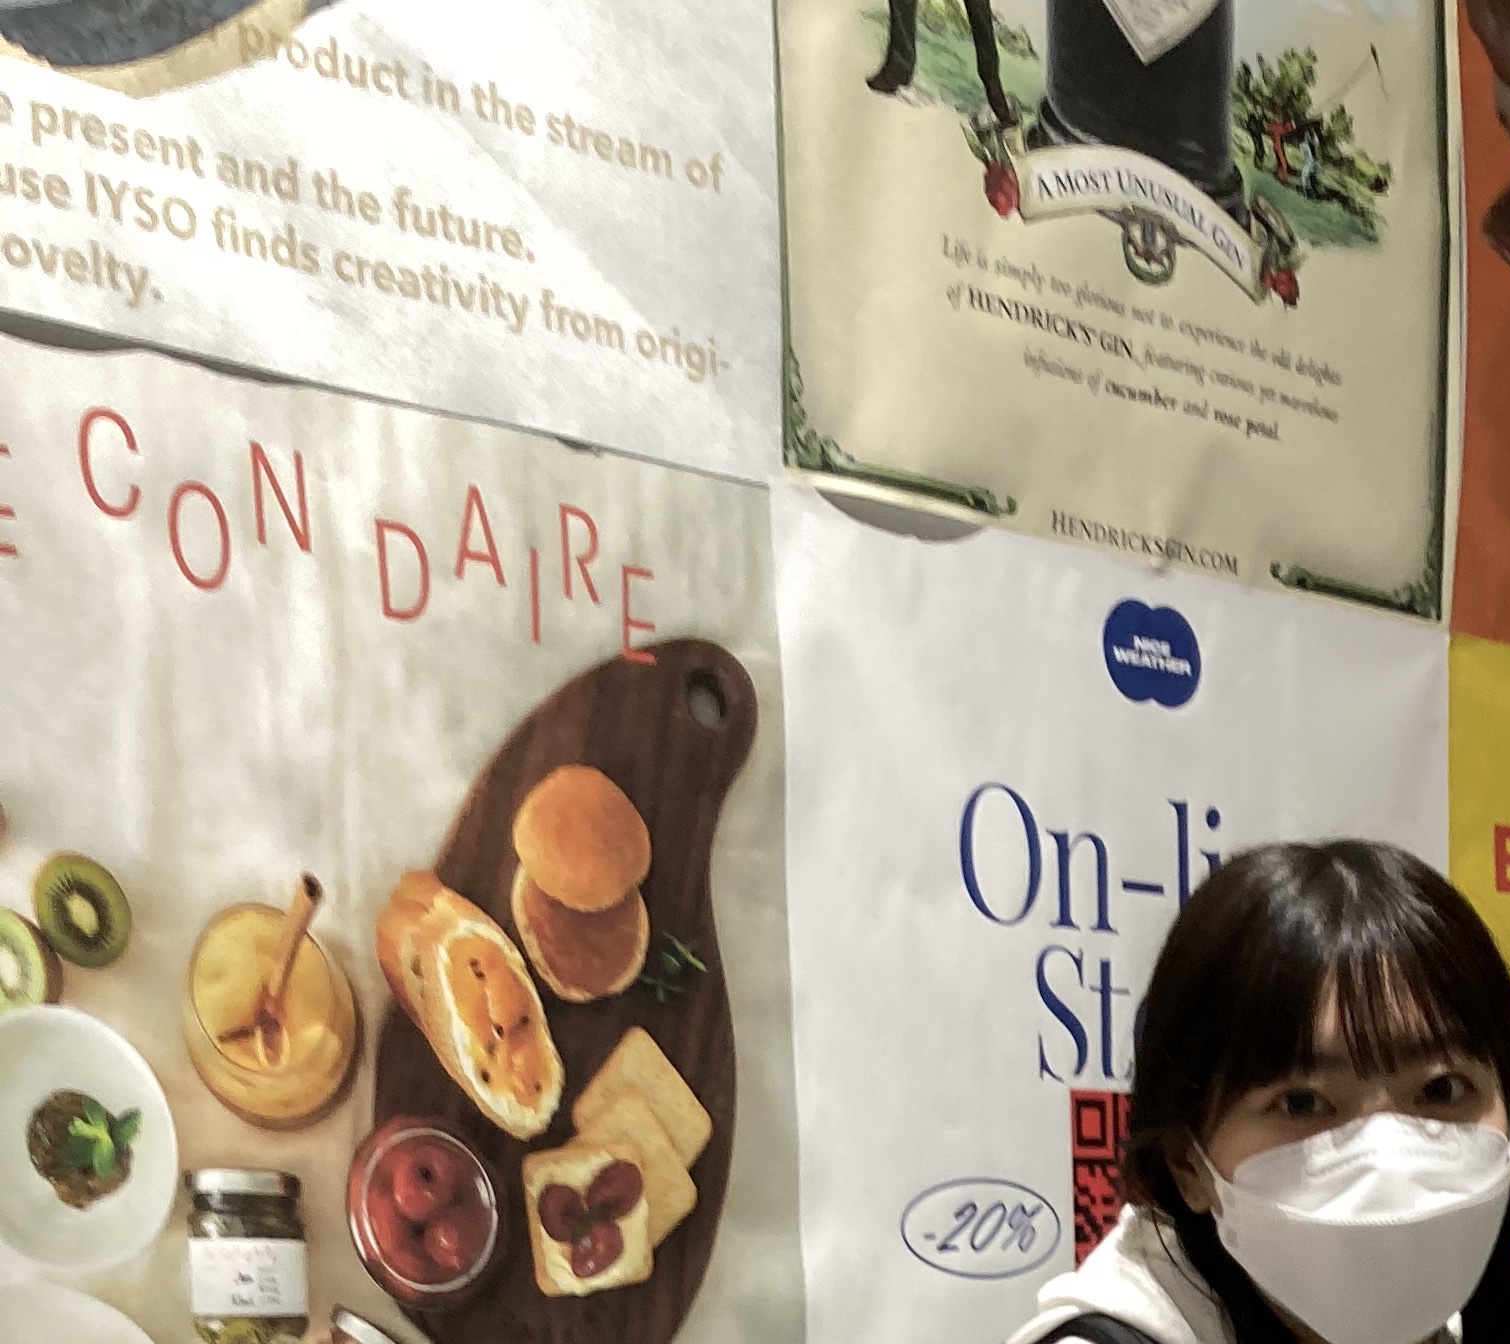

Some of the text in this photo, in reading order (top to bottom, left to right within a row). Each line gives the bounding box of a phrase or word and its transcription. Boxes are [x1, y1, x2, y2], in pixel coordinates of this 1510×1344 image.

[238, 20, 727, 195] product in the stream of
[30, 99, 205, 178] present
[215, 148, 300, 201] and
[312, 165, 382, 224] the
[393, 186, 536, 262] future.
[1037, 168, 1245, 272] A MOST UNUSUAL GIN
[84, 171, 197, 241] IYSO
[211, 208, 321, 276] finds
[334, 253, 530, 334] creativity
[540, 290, 625, 351] from
[636, 326, 731, 383] origi-
[942, 233, 973, 267] Life
[1051, 508, 1239, 576] HENDRICKSGIN.COM
[1037, 944, 1136, 1083] St
[923, 1200, 1044, 1253] -20%
